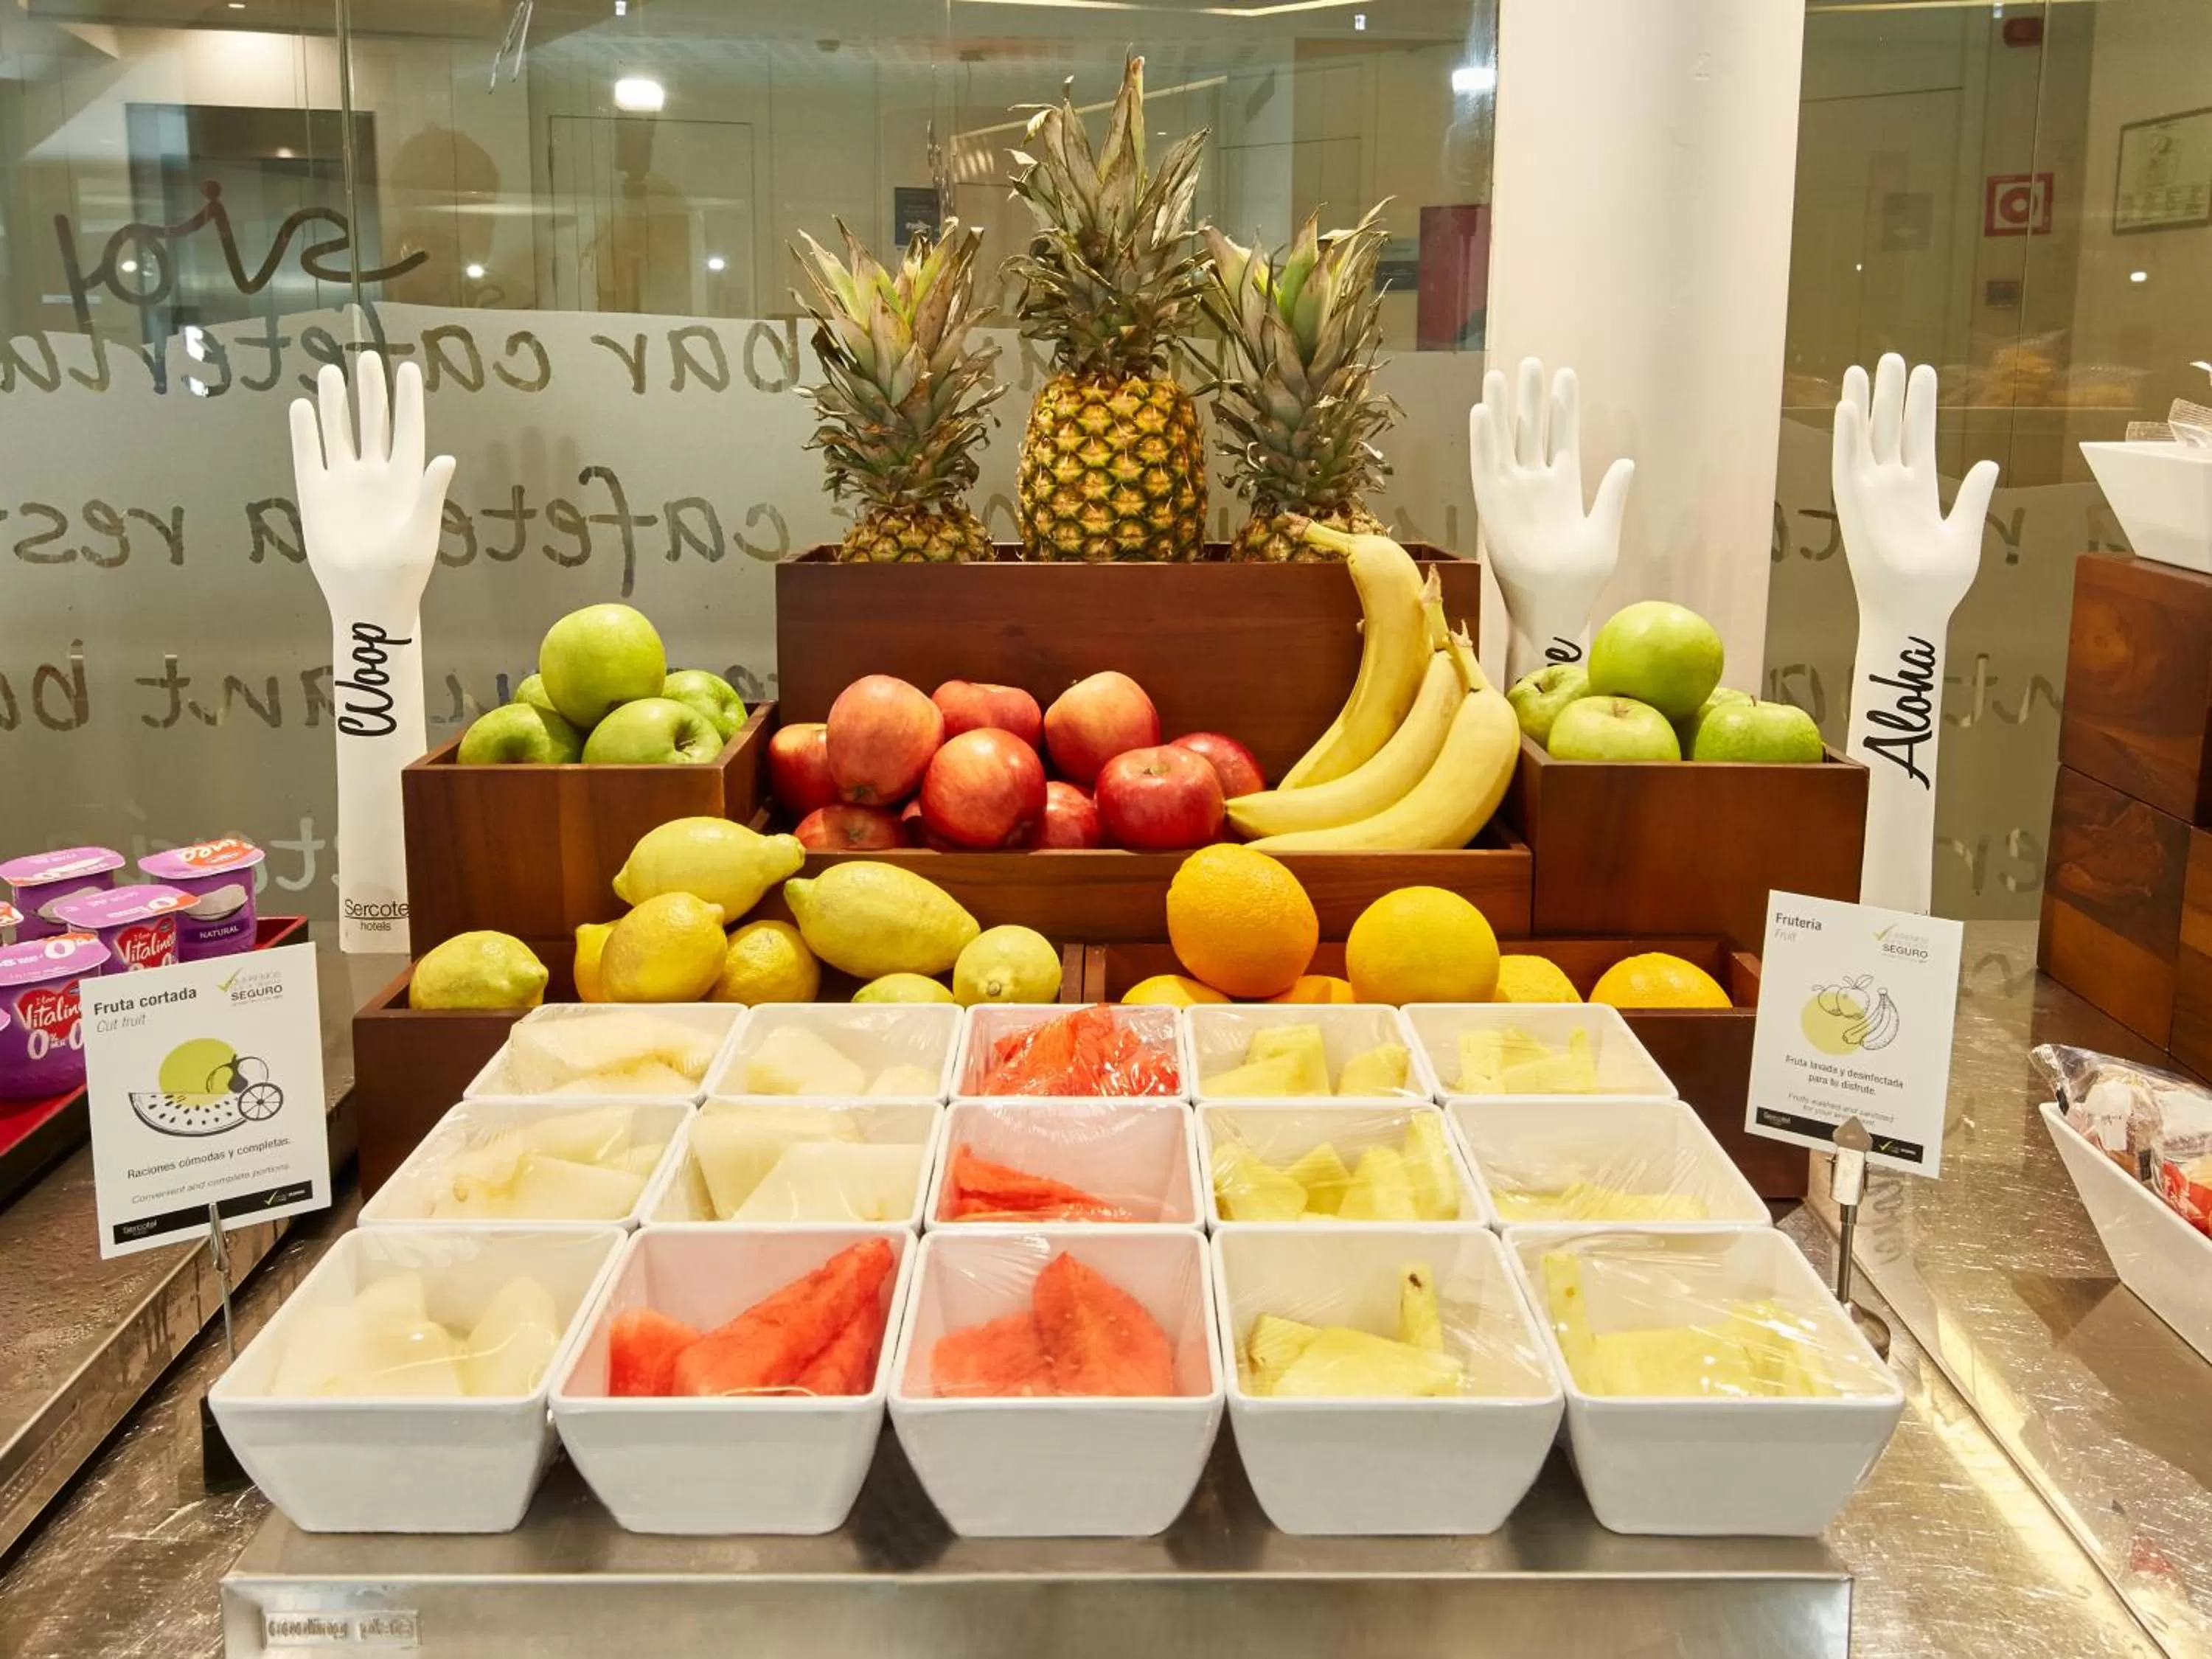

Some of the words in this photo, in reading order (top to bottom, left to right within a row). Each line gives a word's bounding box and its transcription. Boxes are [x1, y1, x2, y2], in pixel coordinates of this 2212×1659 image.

[335, 622, 412, 737] Woop
[1863, 636, 1935, 790] Aloha
[200, 925, 240, 939] NATURAL
[1882, 943, 1928, 959] SEGURO
[94, 998, 134, 1015] Fruta
[139, 987, 197, 1007] cortada
[231, 984, 283, 1001] SEGURO
[13, 995, 82, 1030] Vitalin
[97, 1019, 118, 1033] Cut
[121, 1014, 146, 1027] fruit
[1785, 1054, 1807, 1067] Fruta
[1810, 1060, 1837, 1074] lavada
[1840, 1068, 1845, 1077] y
[1808, 1074, 1828, 1084] para
[1830, 1078, 1840, 1088] tu
[128, 1163, 176, 1179] Raciones
[178, 1152, 225, 1169] cómodas
[228, 1150, 234, 1159] y
[237, 1138, 291, 1155] completas.
